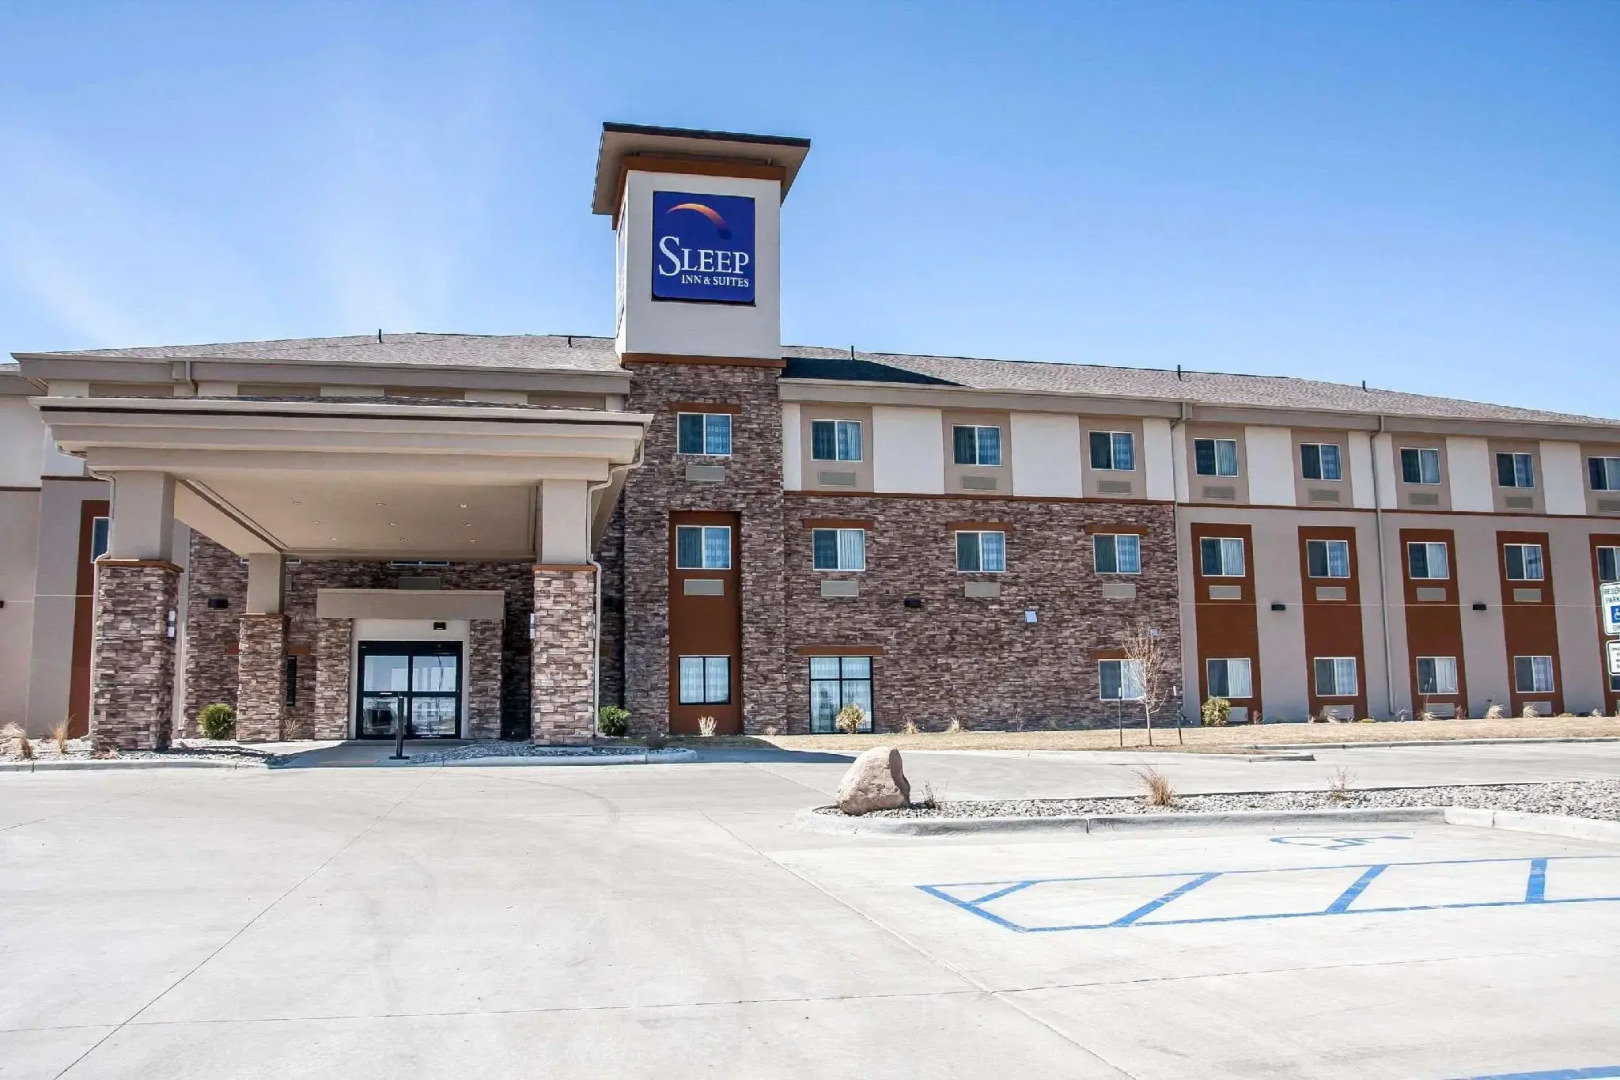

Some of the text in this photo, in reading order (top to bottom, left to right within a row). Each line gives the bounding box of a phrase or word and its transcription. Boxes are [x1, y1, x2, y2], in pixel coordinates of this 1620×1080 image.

[658, 236, 749, 276] SLEEP
[681, 275, 749, 288] INN & SUITES
